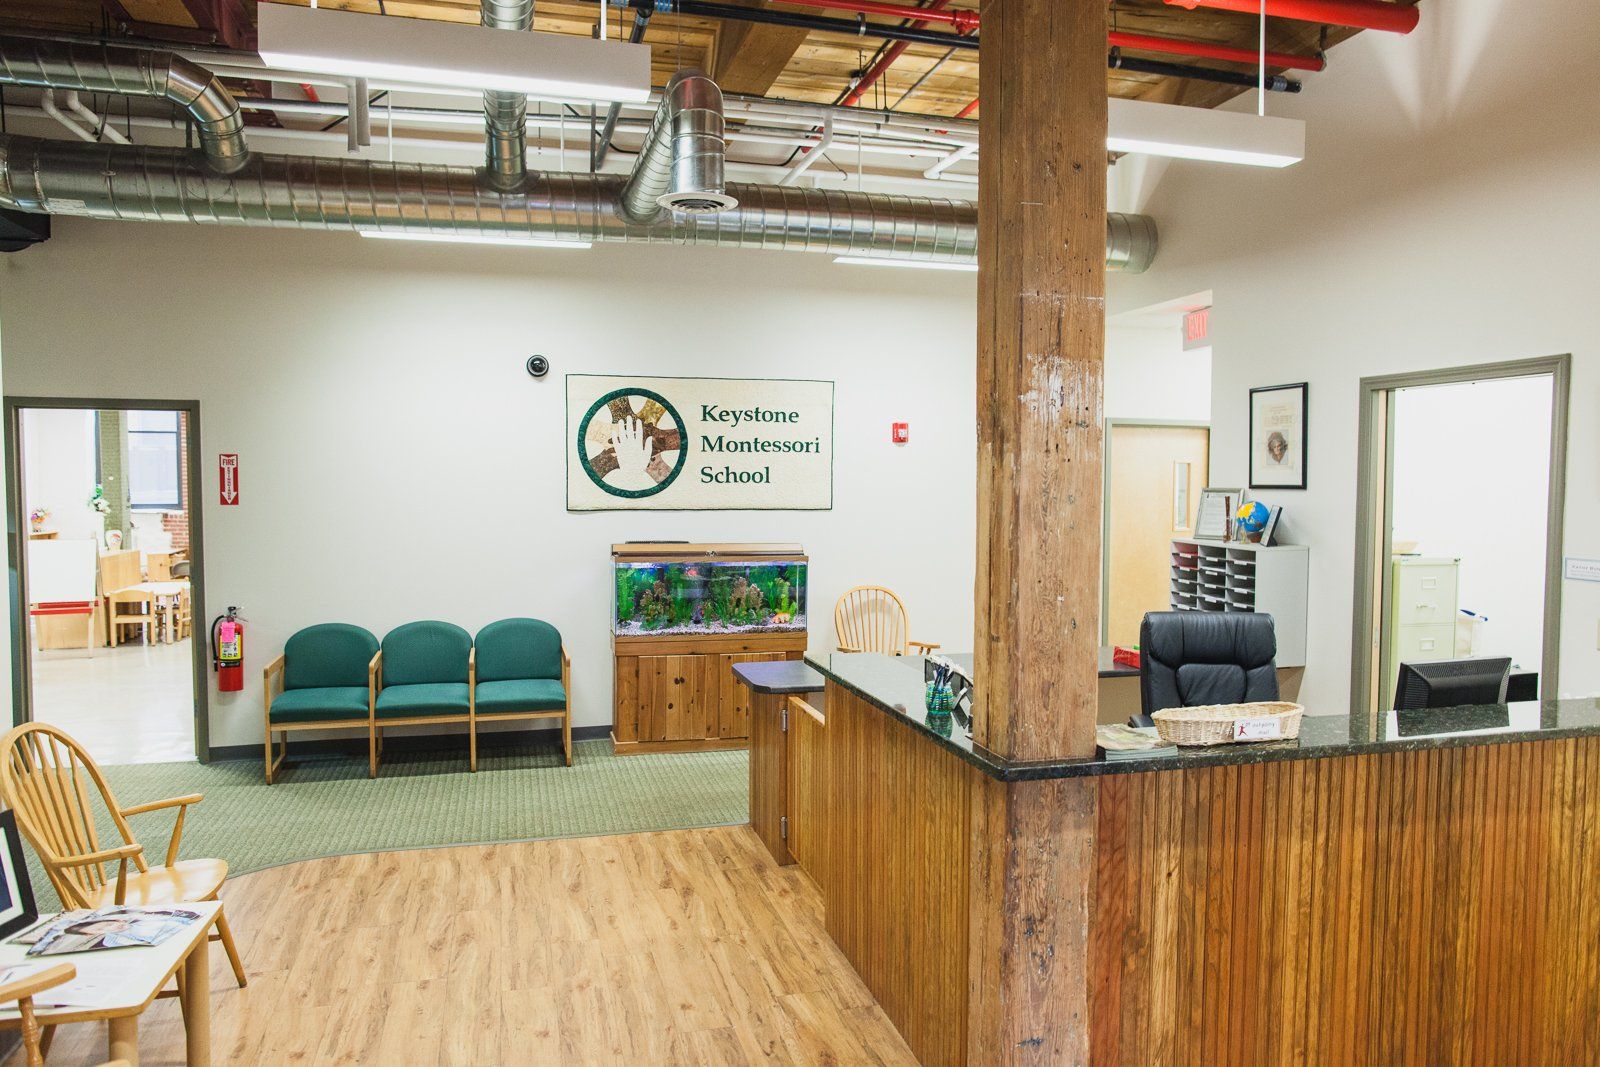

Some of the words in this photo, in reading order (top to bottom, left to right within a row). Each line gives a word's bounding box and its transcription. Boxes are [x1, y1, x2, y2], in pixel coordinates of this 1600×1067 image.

[700, 404, 800, 428] Keystone
[700, 435, 821, 453] Montessori
[222, 458, 235, 466] FIRE
[700, 466, 771, 484] School
